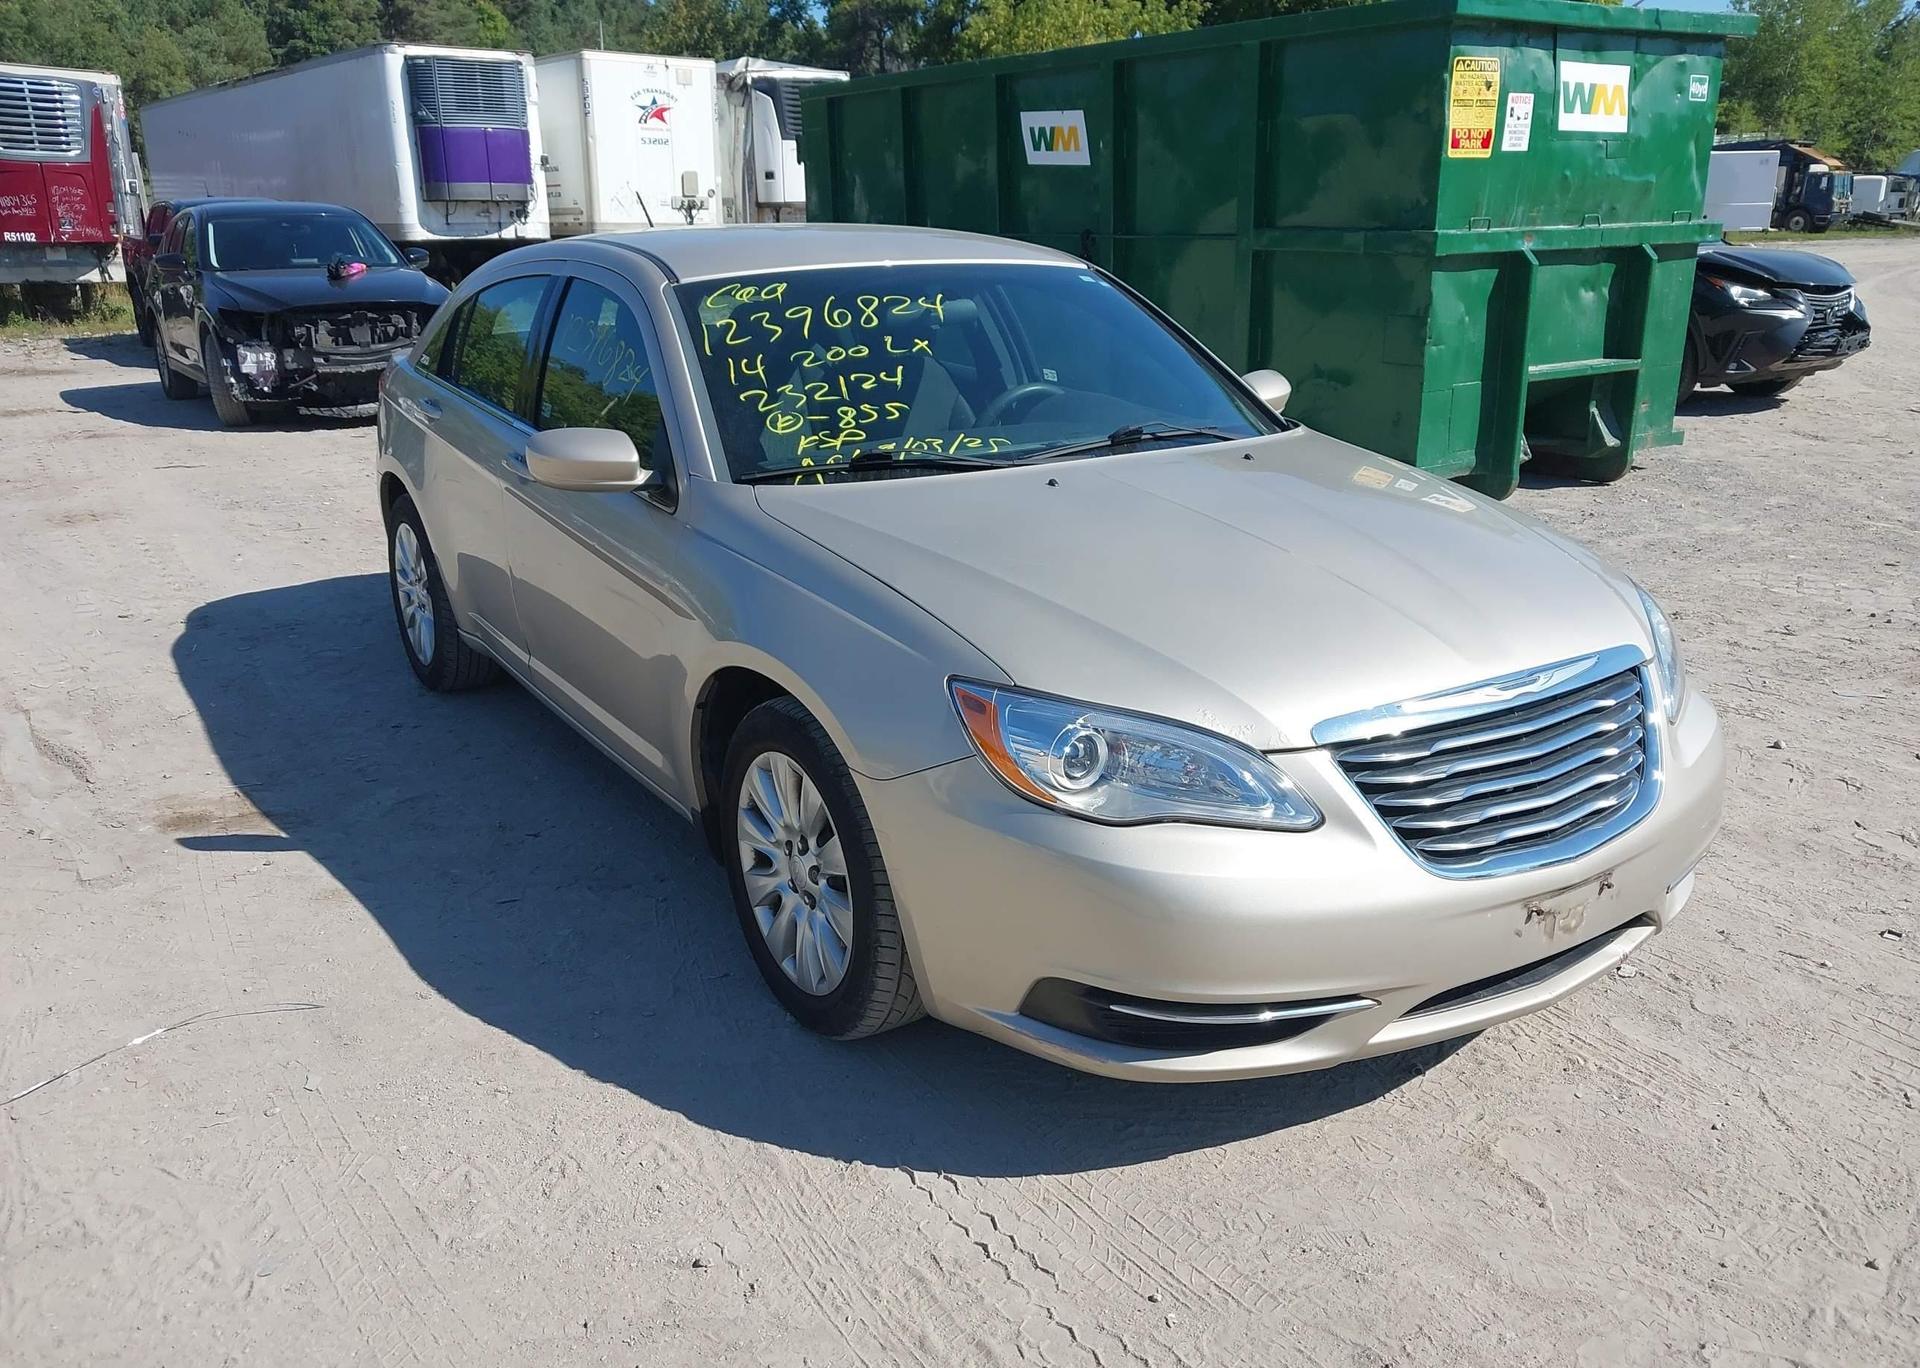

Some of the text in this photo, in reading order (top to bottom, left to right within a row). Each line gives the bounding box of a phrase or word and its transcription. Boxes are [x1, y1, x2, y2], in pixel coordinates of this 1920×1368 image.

[1464, 60, 1498, 71] CAUTION
[642, 88, 678, 104] TRANSPORT
[1511, 96, 1531, 105] NOTICE
[1562, 81, 1627, 116] WM
[1029, 126, 1081, 152] WM
[1455, 129, 1490, 139] DO NOT
[1459, 139, 1483, 149] PARK
[4, 231, 37, 242] R51102
[702, 293, 945, 356] 12396824
[727, 353, 768, 387] 14
[791, 345, 870, 368] 200
[740, 364, 904, 413] 232124
